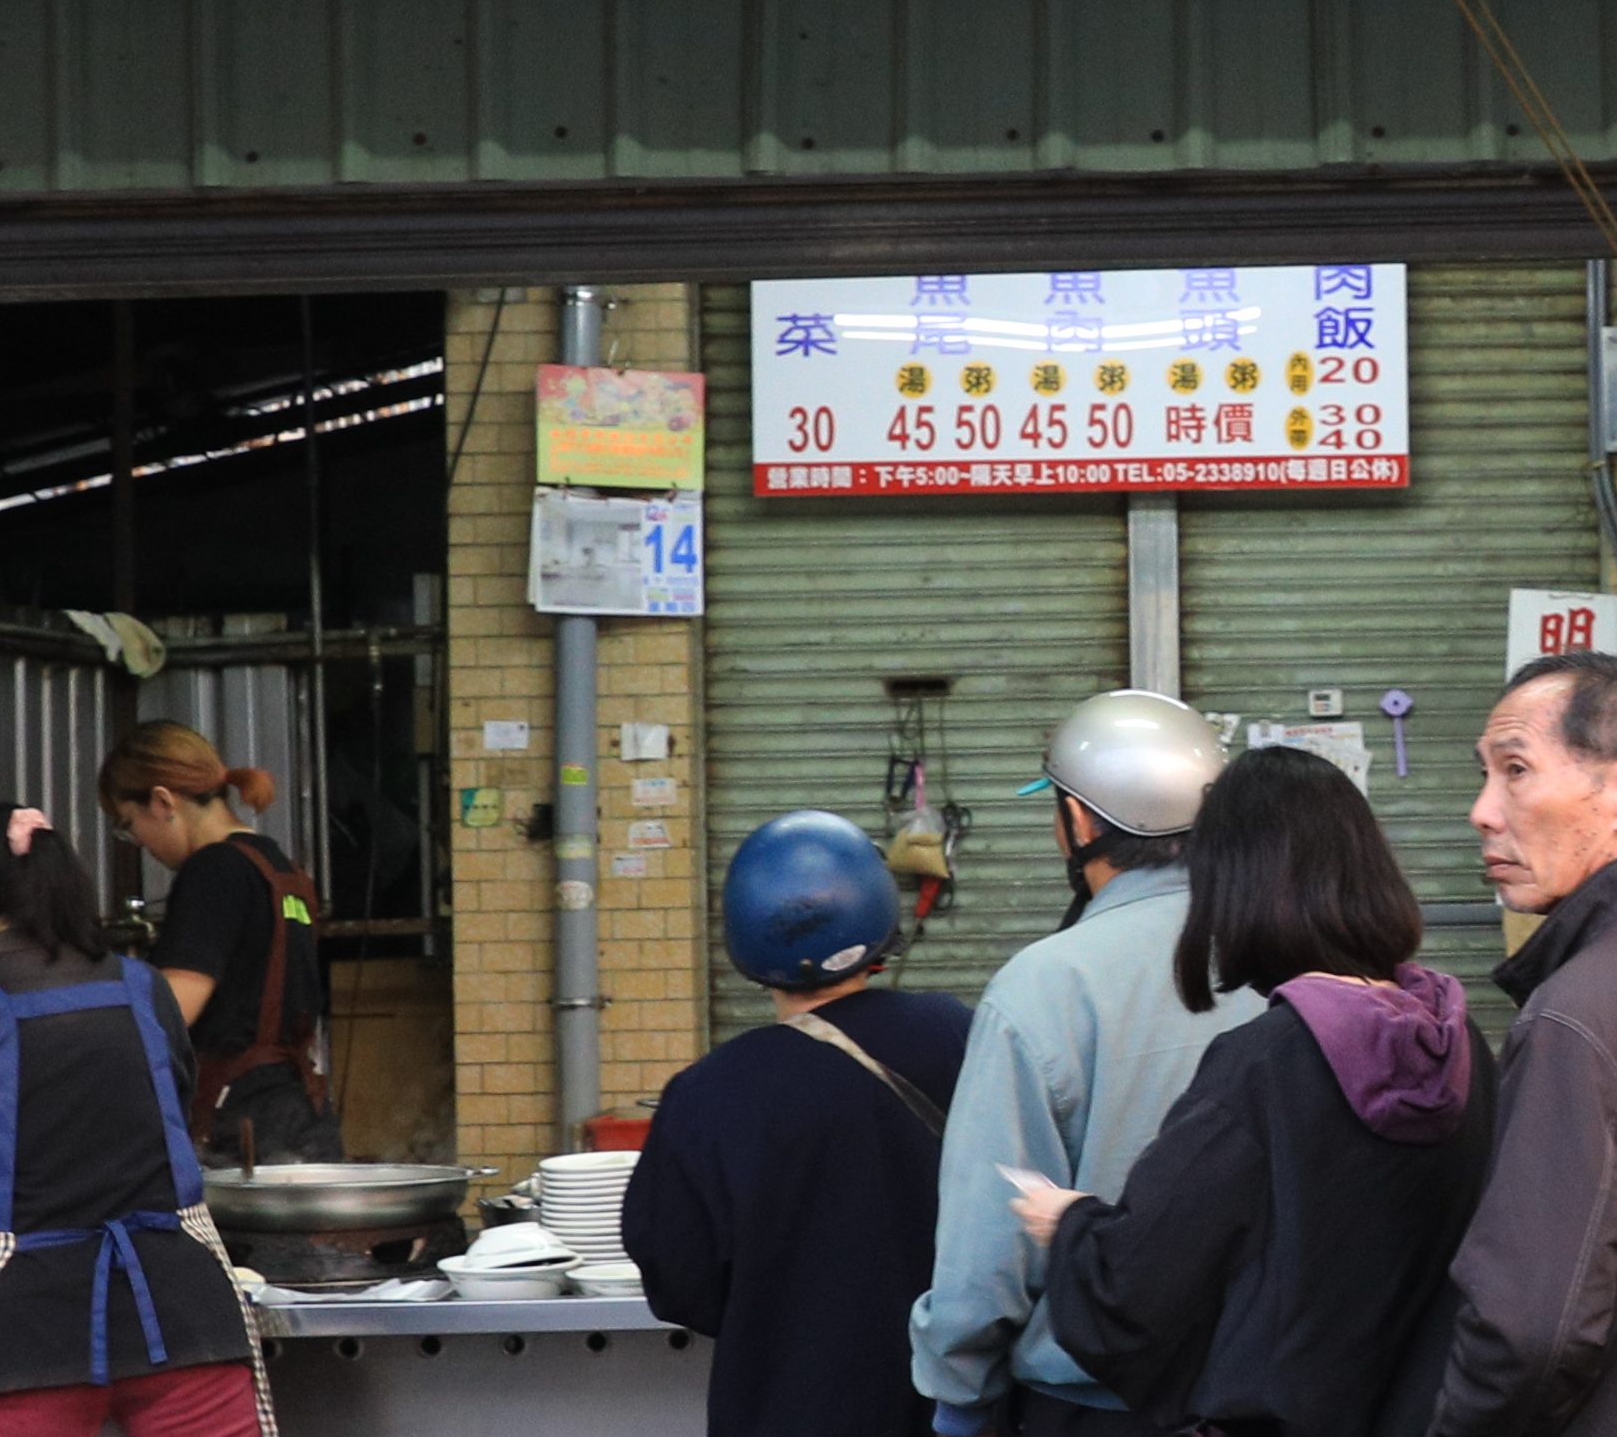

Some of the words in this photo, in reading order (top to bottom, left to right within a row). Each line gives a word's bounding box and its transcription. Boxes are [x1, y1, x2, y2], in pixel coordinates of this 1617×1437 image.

[1319, 357, 1380, 384] 20
[788, 406, 835, 452] 30
[887, 405, 935, 451] 45
[954, 404, 1001, 450] 50
[1019, 403, 1068, 449] 45
[1087, 403, 1134, 448] 50
[1165, 403, 1255, 445] 時價
[1318, 404, 1383, 426] 30
[1318, 429, 1383, 450] 40
[645, 524, 698, 574] 14
